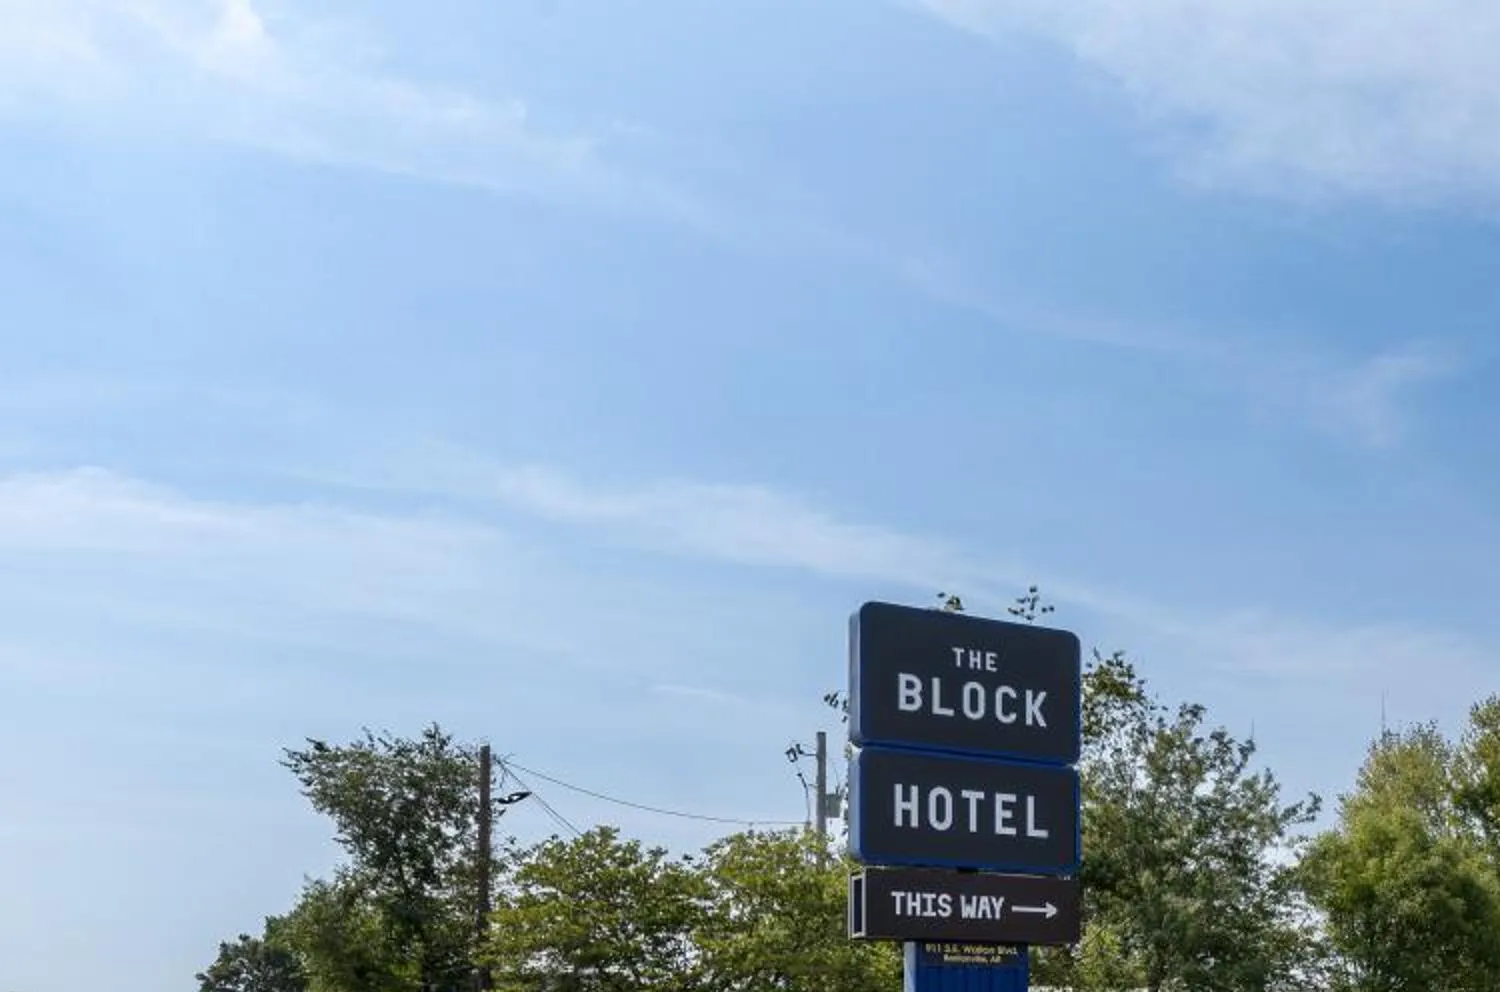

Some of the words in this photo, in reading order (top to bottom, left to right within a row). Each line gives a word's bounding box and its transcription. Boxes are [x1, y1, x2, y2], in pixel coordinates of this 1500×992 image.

[953, 647, 998, 672] THE
[898, 673, 1047, 727] BLOCK
[894, 783, 1049, 838] HOTEL
[891, 890, 952, 918] THIS
[960, 894, 1005, 920] WAY
